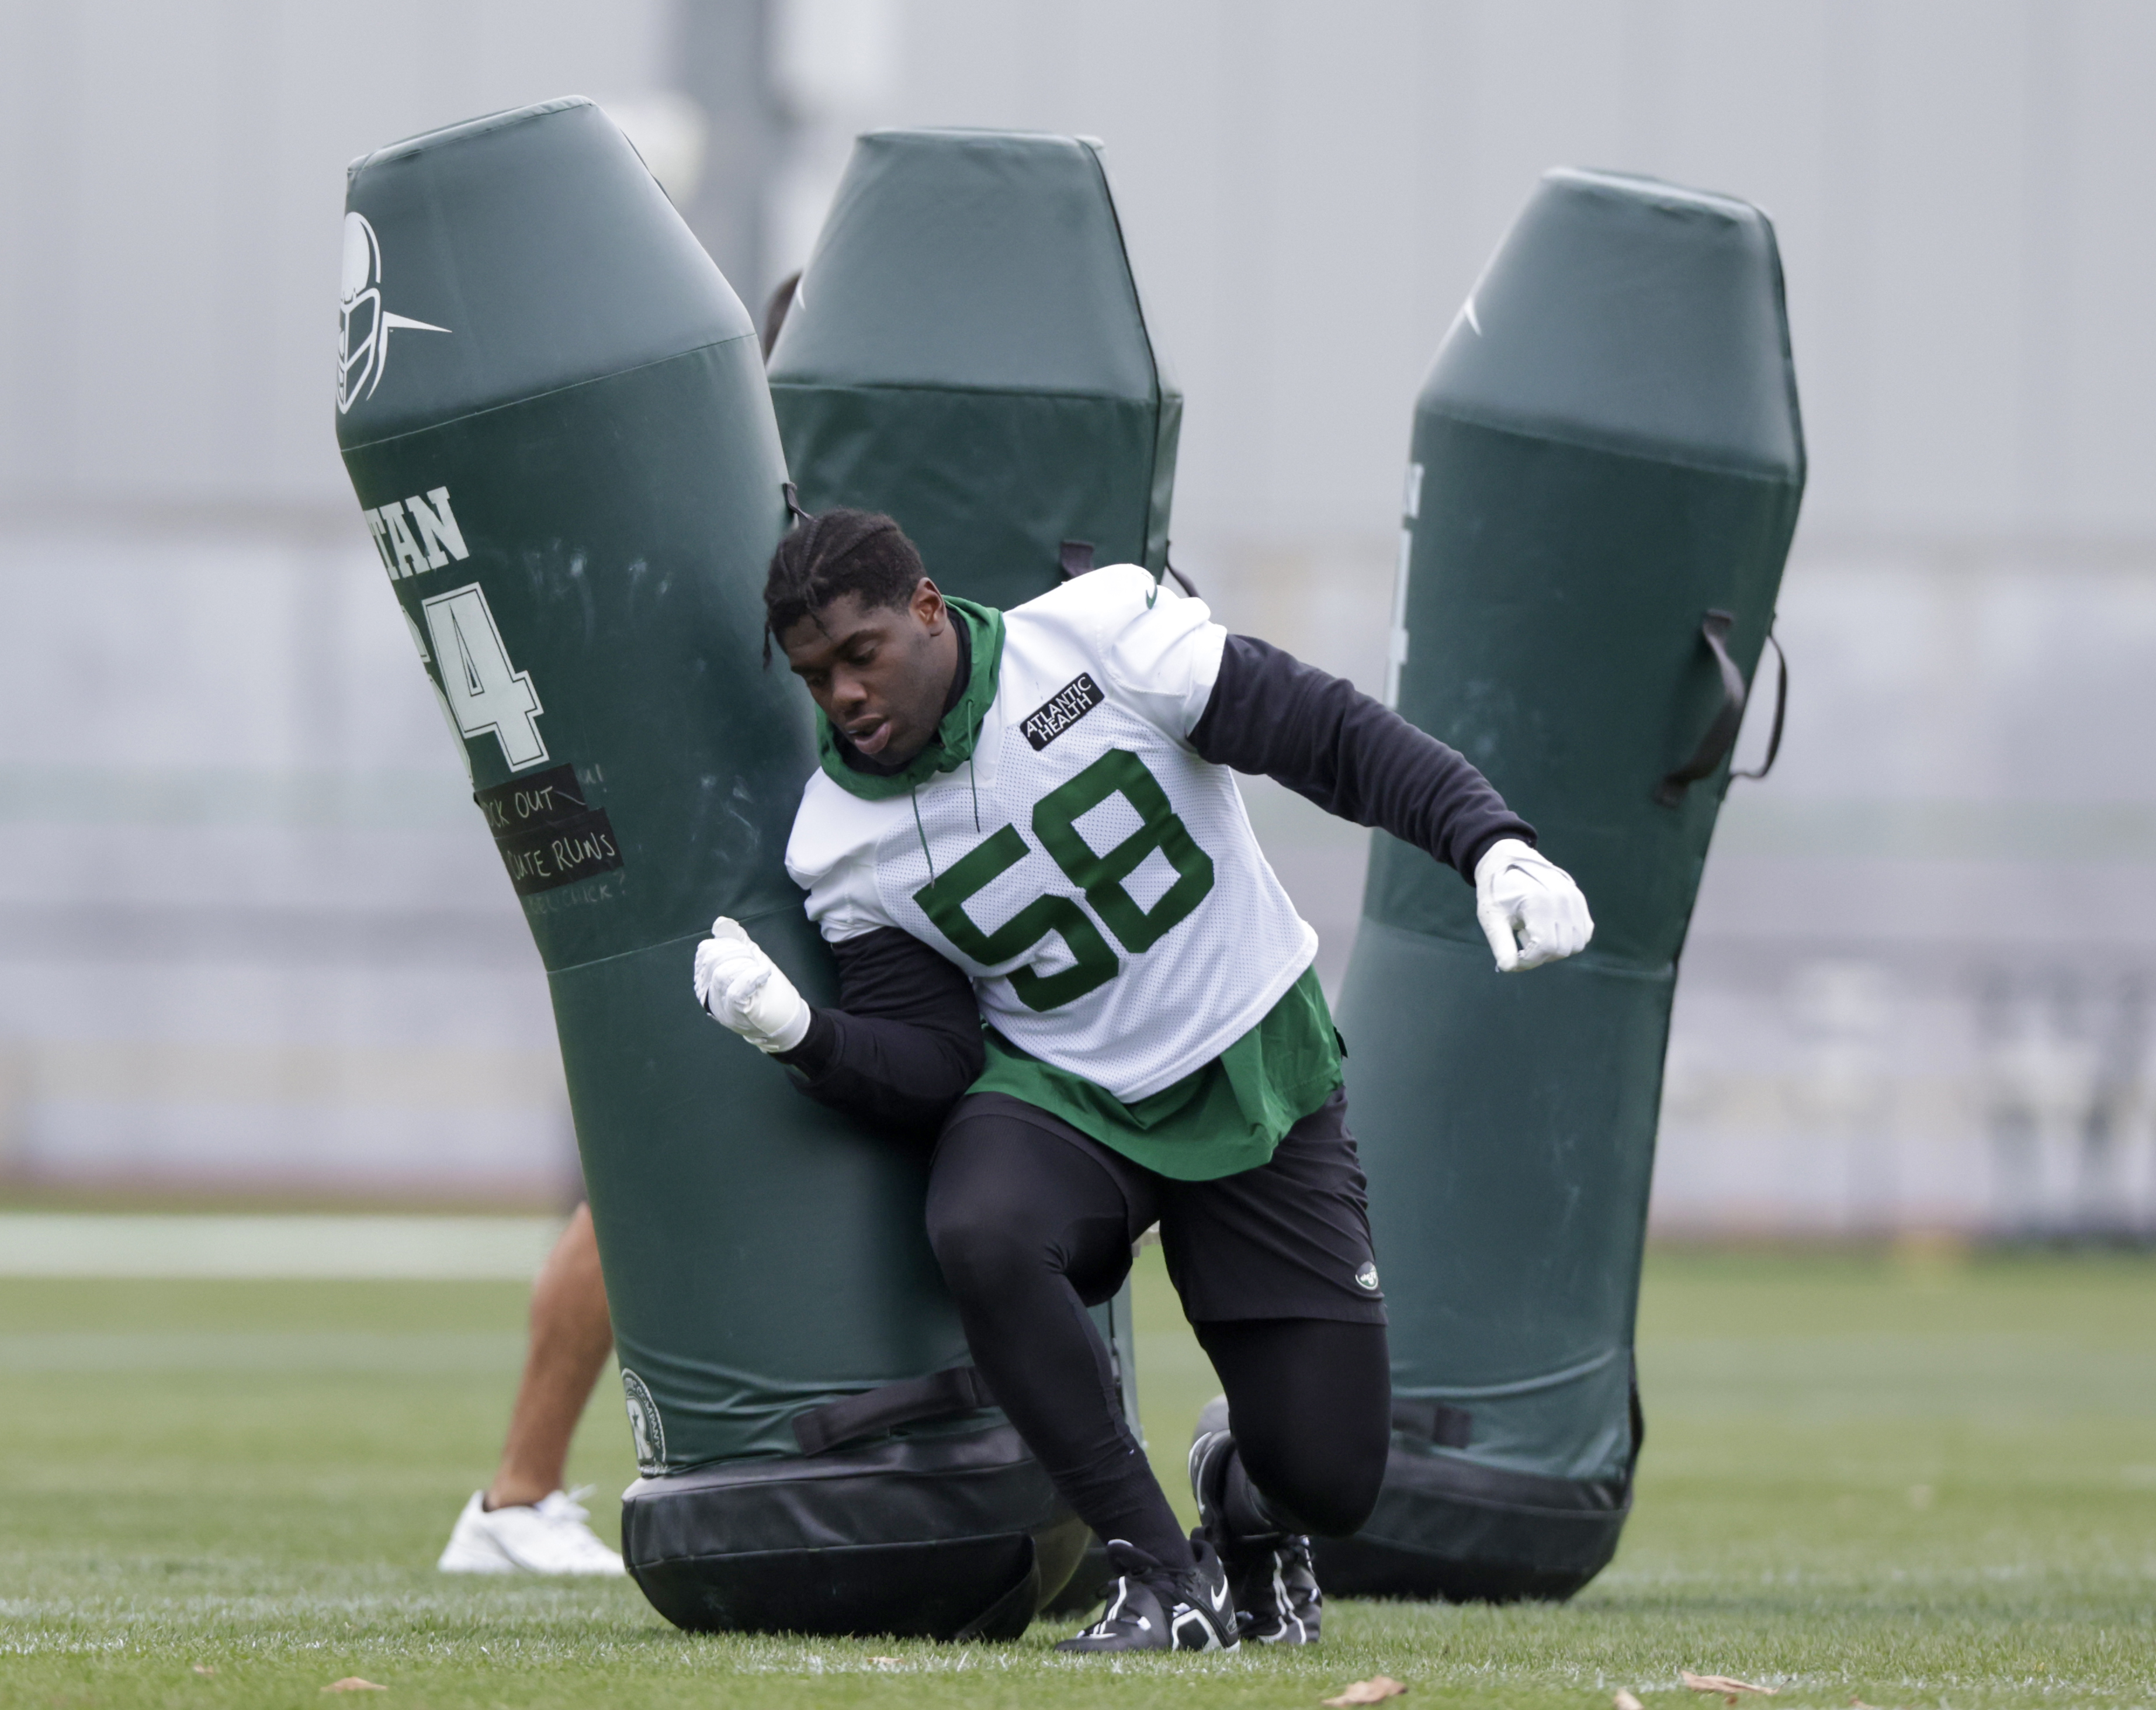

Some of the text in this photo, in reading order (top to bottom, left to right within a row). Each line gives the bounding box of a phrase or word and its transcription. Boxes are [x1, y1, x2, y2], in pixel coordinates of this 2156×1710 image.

[1026, 676, 1091, 738] ATLANTIC
[1038, 692, 1093, 741] HEALTH
[515, 785, 553, 818] OUT
[552, 832, 615, 871] RUNS
[912, 747, 1215, 1012] 58
[636, 1386, 661, 1449] COMPANY
